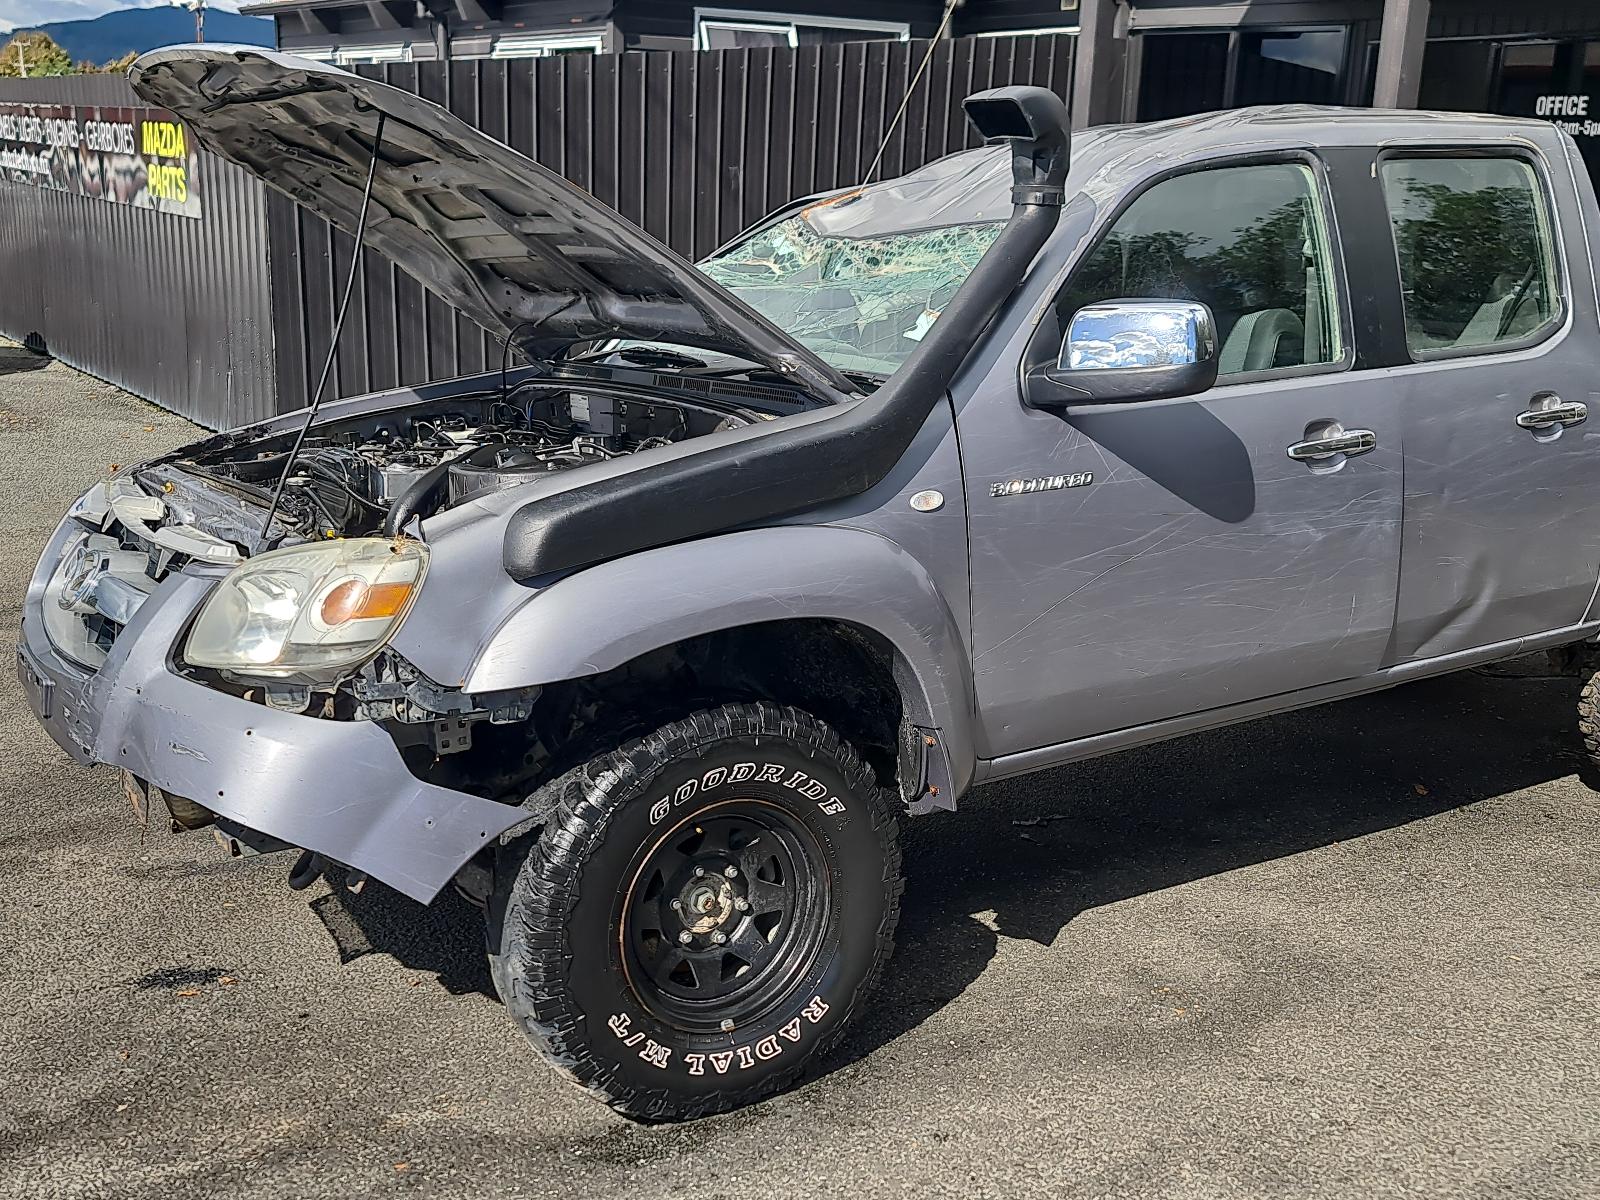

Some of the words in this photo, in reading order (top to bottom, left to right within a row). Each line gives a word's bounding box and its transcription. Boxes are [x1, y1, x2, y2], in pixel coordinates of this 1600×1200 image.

[1536, 95, 1589, 115] OFFICE
[18, 115, 42, 144] LIGHTS
[44, 118, 79, 148] ENGINES
[85, 120, 134, 154] GEARBOXES
[141, 120, 187, 159] MAZDA
[147, 164, 187, 203] PARTS
[649, 763, 847, 825] GOODRIDE
[607, 1011, 671, 1070] M/T
[685, 996, 831, 1076] RADIAL
